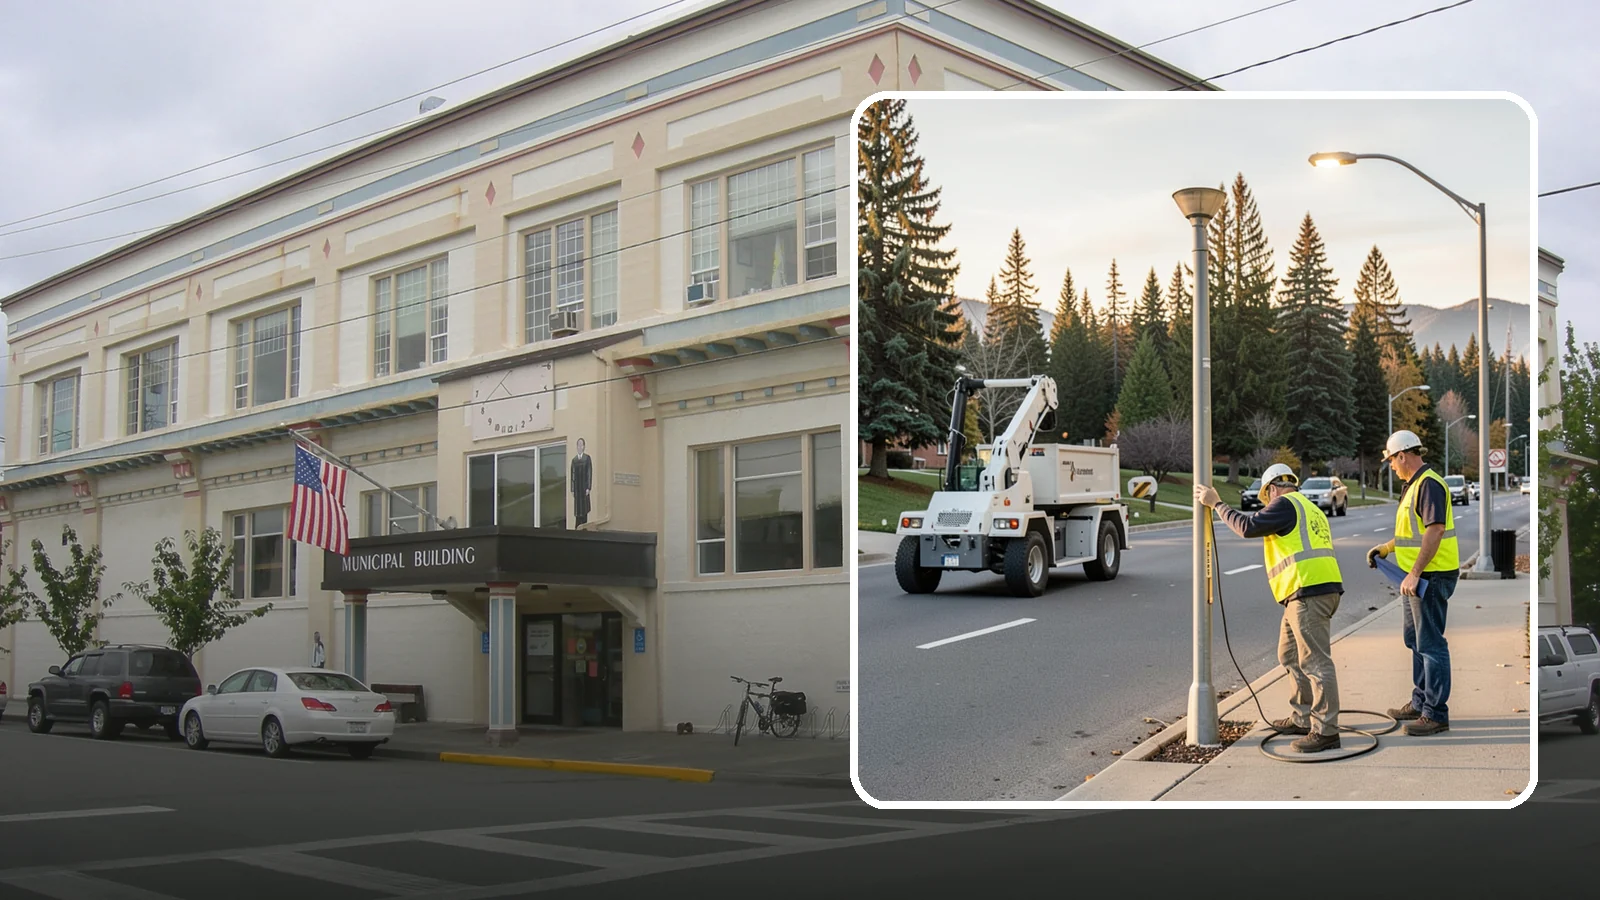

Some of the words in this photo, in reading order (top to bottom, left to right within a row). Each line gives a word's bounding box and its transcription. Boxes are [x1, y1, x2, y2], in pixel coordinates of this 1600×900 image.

[521, 420, 526, 428] 2
[342, 552, 405, 572] MUNICIPAL
[414, 546, 475, 567] BUILDING
